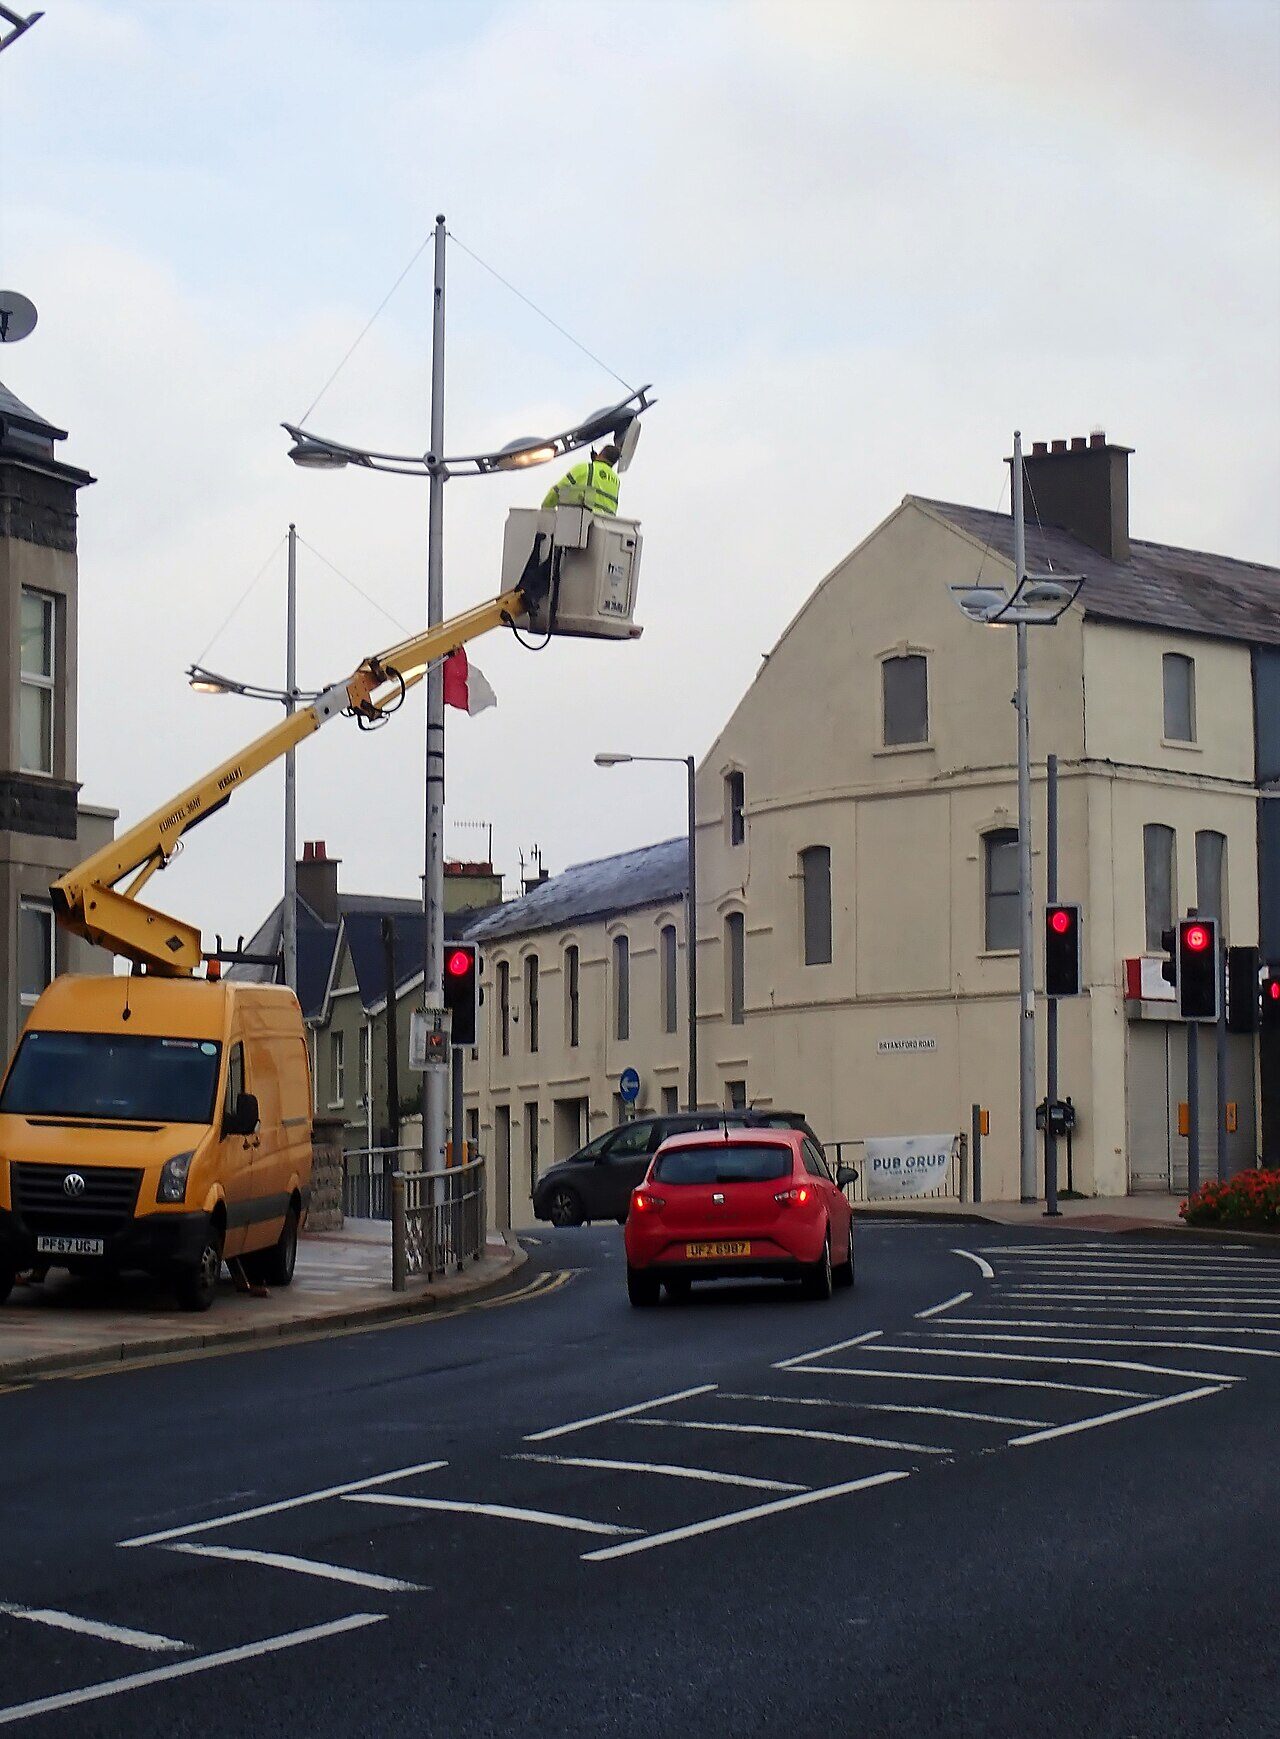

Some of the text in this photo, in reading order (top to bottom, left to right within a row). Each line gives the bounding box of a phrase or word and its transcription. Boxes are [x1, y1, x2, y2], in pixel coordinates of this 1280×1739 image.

[159, 808, 185, 833] EUROTEL
[879, 1040, 935, 1050] BRYANSFORD ROAD
[873, 1154, 946, 1171] PUB GRUB
